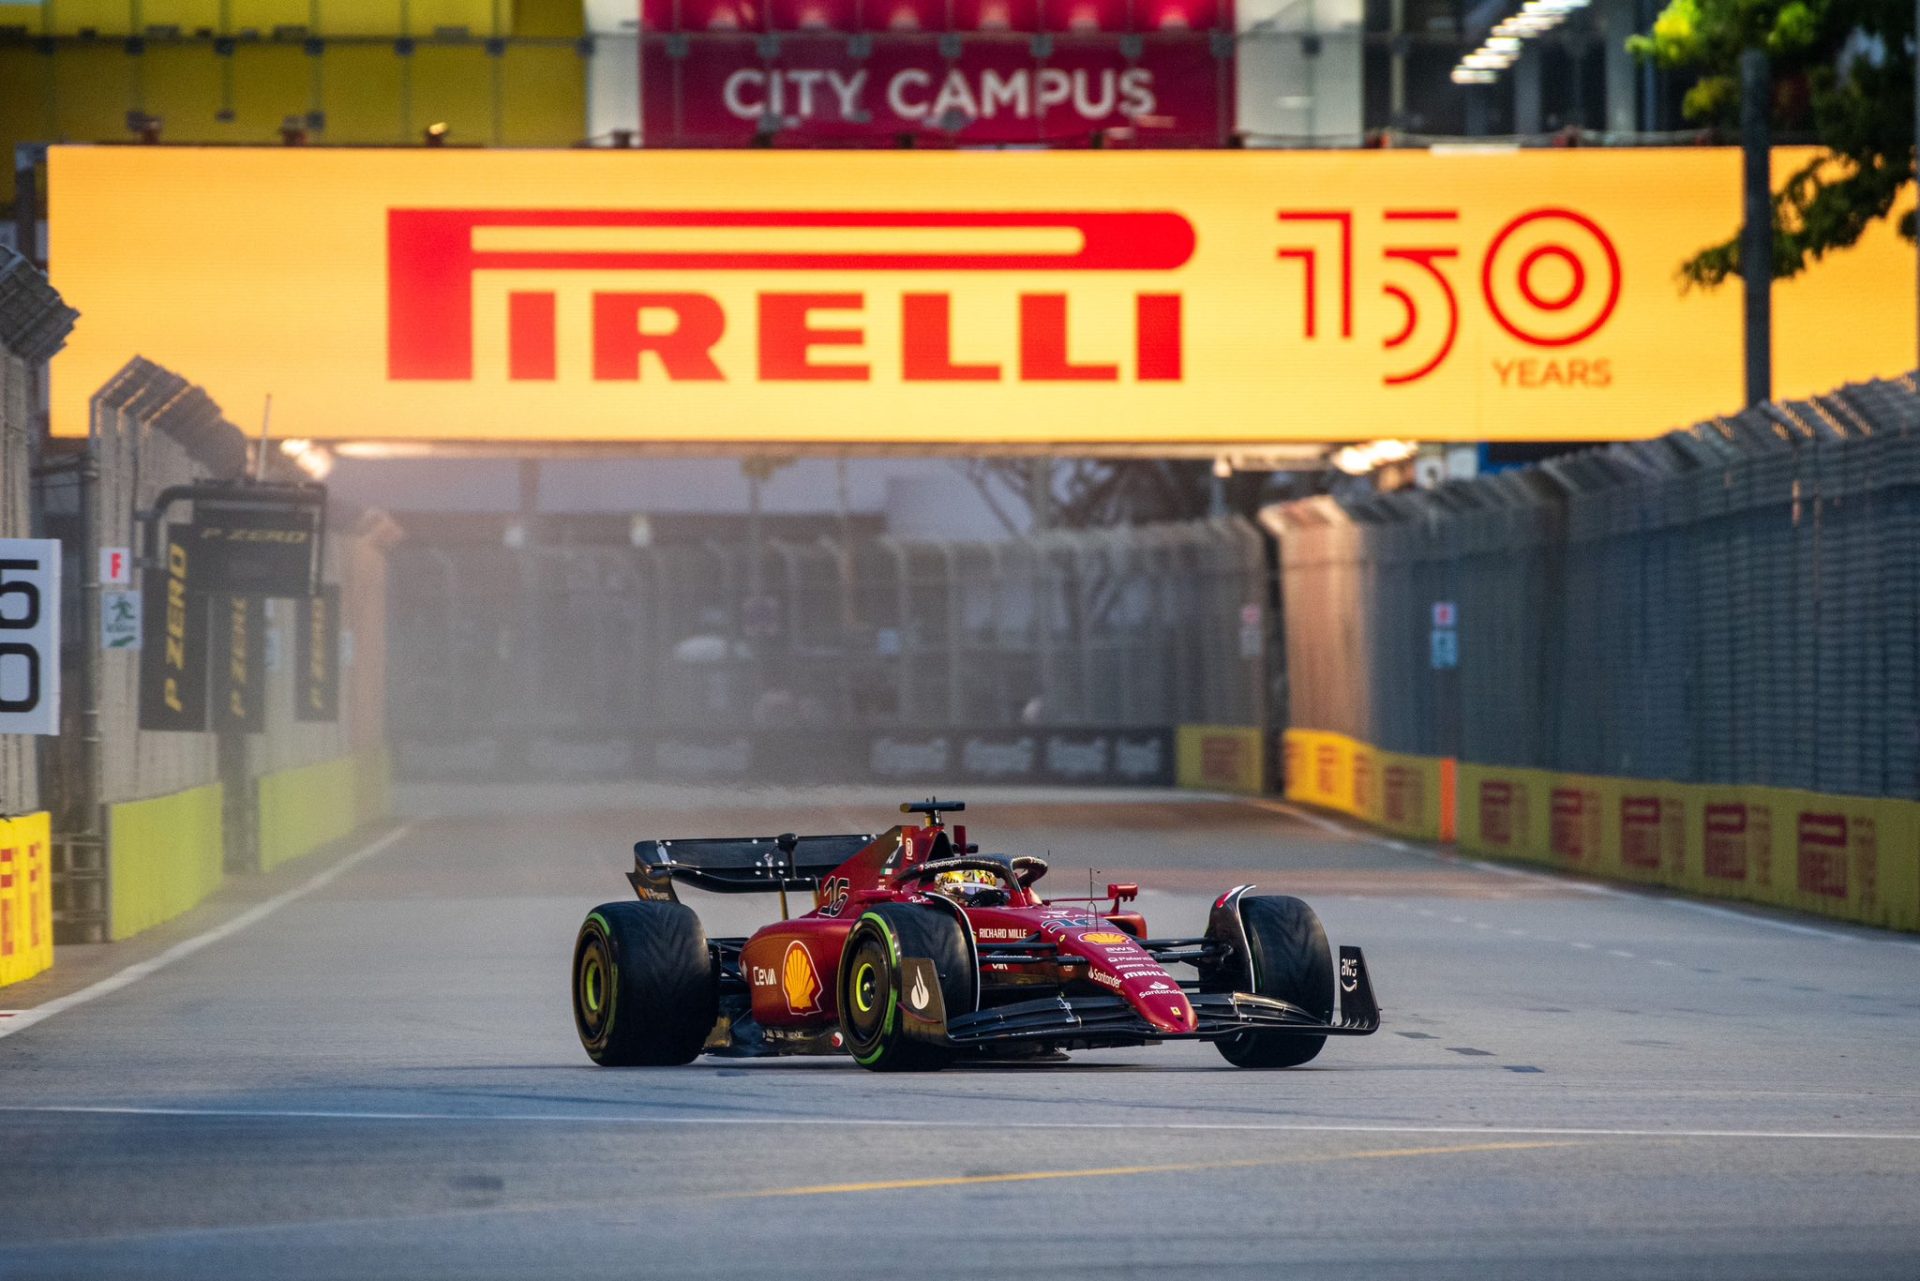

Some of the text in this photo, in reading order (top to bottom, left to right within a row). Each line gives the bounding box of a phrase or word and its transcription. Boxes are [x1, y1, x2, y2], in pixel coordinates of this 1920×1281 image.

[723, 69, 1157, 118] CITY CAMPUS
[387, 207, 1622, 386] PIRELLI 150
[1493, 358, 1613, 388] YEARS
[110, 552, 122, 579] F
[164, 542, 187, 712] P ZERO
[818, 875, 850, 917] 16
[979, 928, 1027, 939] RICHARD MILLE
[1094, 969, 1122, 989] Santander
